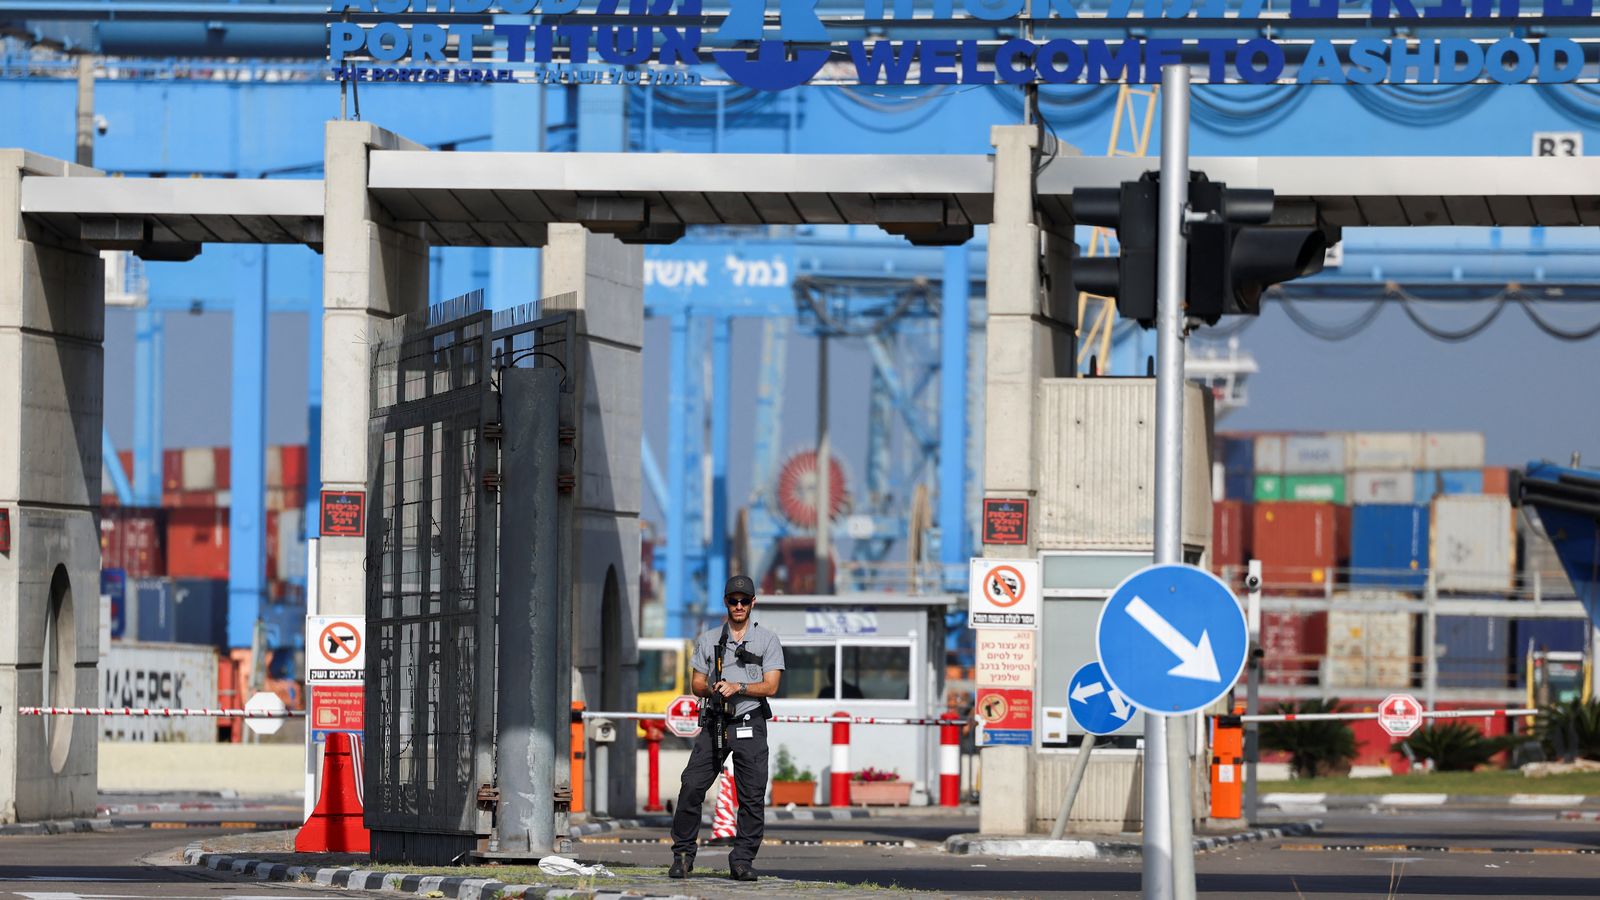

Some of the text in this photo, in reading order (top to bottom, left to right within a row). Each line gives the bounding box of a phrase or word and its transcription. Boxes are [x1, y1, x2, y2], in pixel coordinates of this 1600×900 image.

[329, 22, 483, 63] PORT
[493, 24, 702, 65] אשדוד
[848, 37, 1584, 84] WELCOME TO ASHDOD
[332, 67, 518, 83] THE PORT OF ISRAEL
[535, 67, 603, 85] ישראל
[609, 68, 641, 85] של
[726, 255, 788, 287] נמל
[311, 670, 327, 679] נשק
